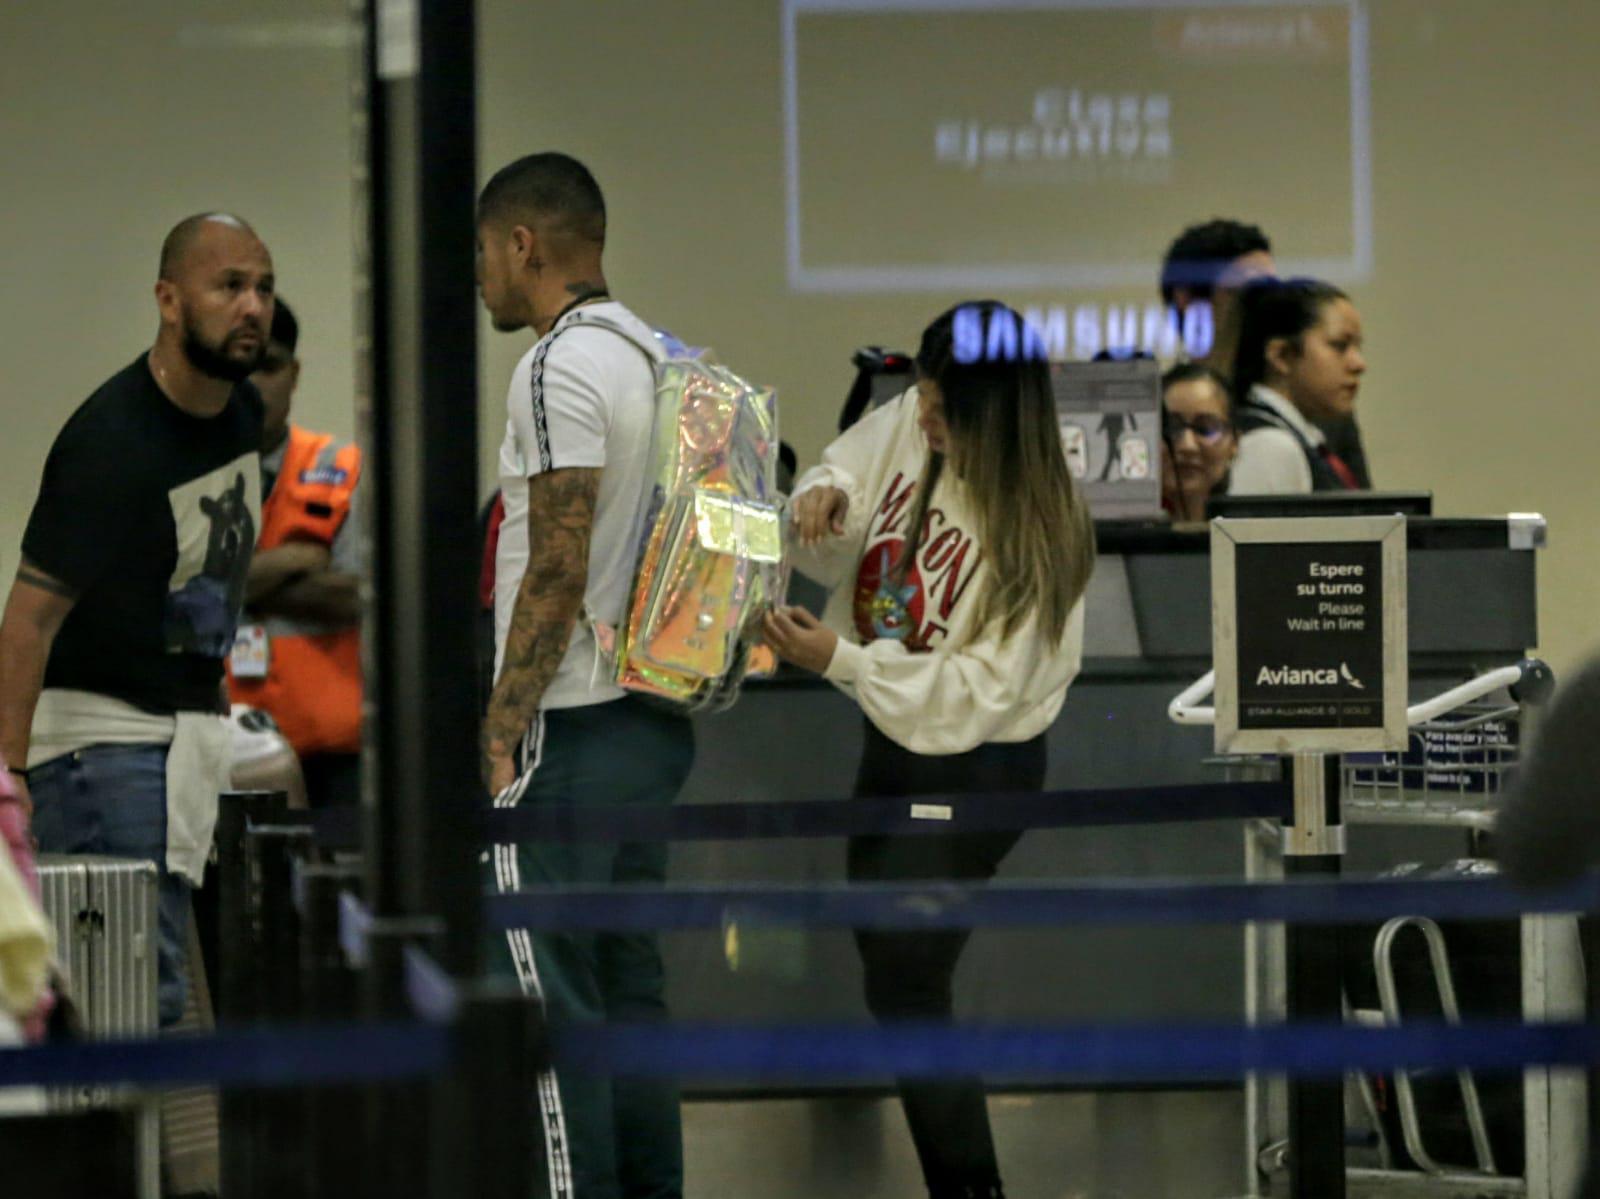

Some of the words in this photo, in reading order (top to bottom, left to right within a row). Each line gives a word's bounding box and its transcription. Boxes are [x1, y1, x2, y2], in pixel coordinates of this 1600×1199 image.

[1309, 561, 1364, 580] Espere
[1296, 583, 1316, 596] su
[1319, 581, 1365, 596] turno
[1318, 601, 1365, 615] Please
[1287, 617, 1320, 631] Wait
[1323, 617, 1336, 630] in
[1339, 617, 1365, 630] line
[1256, 665, 1338, 686] Avianca
